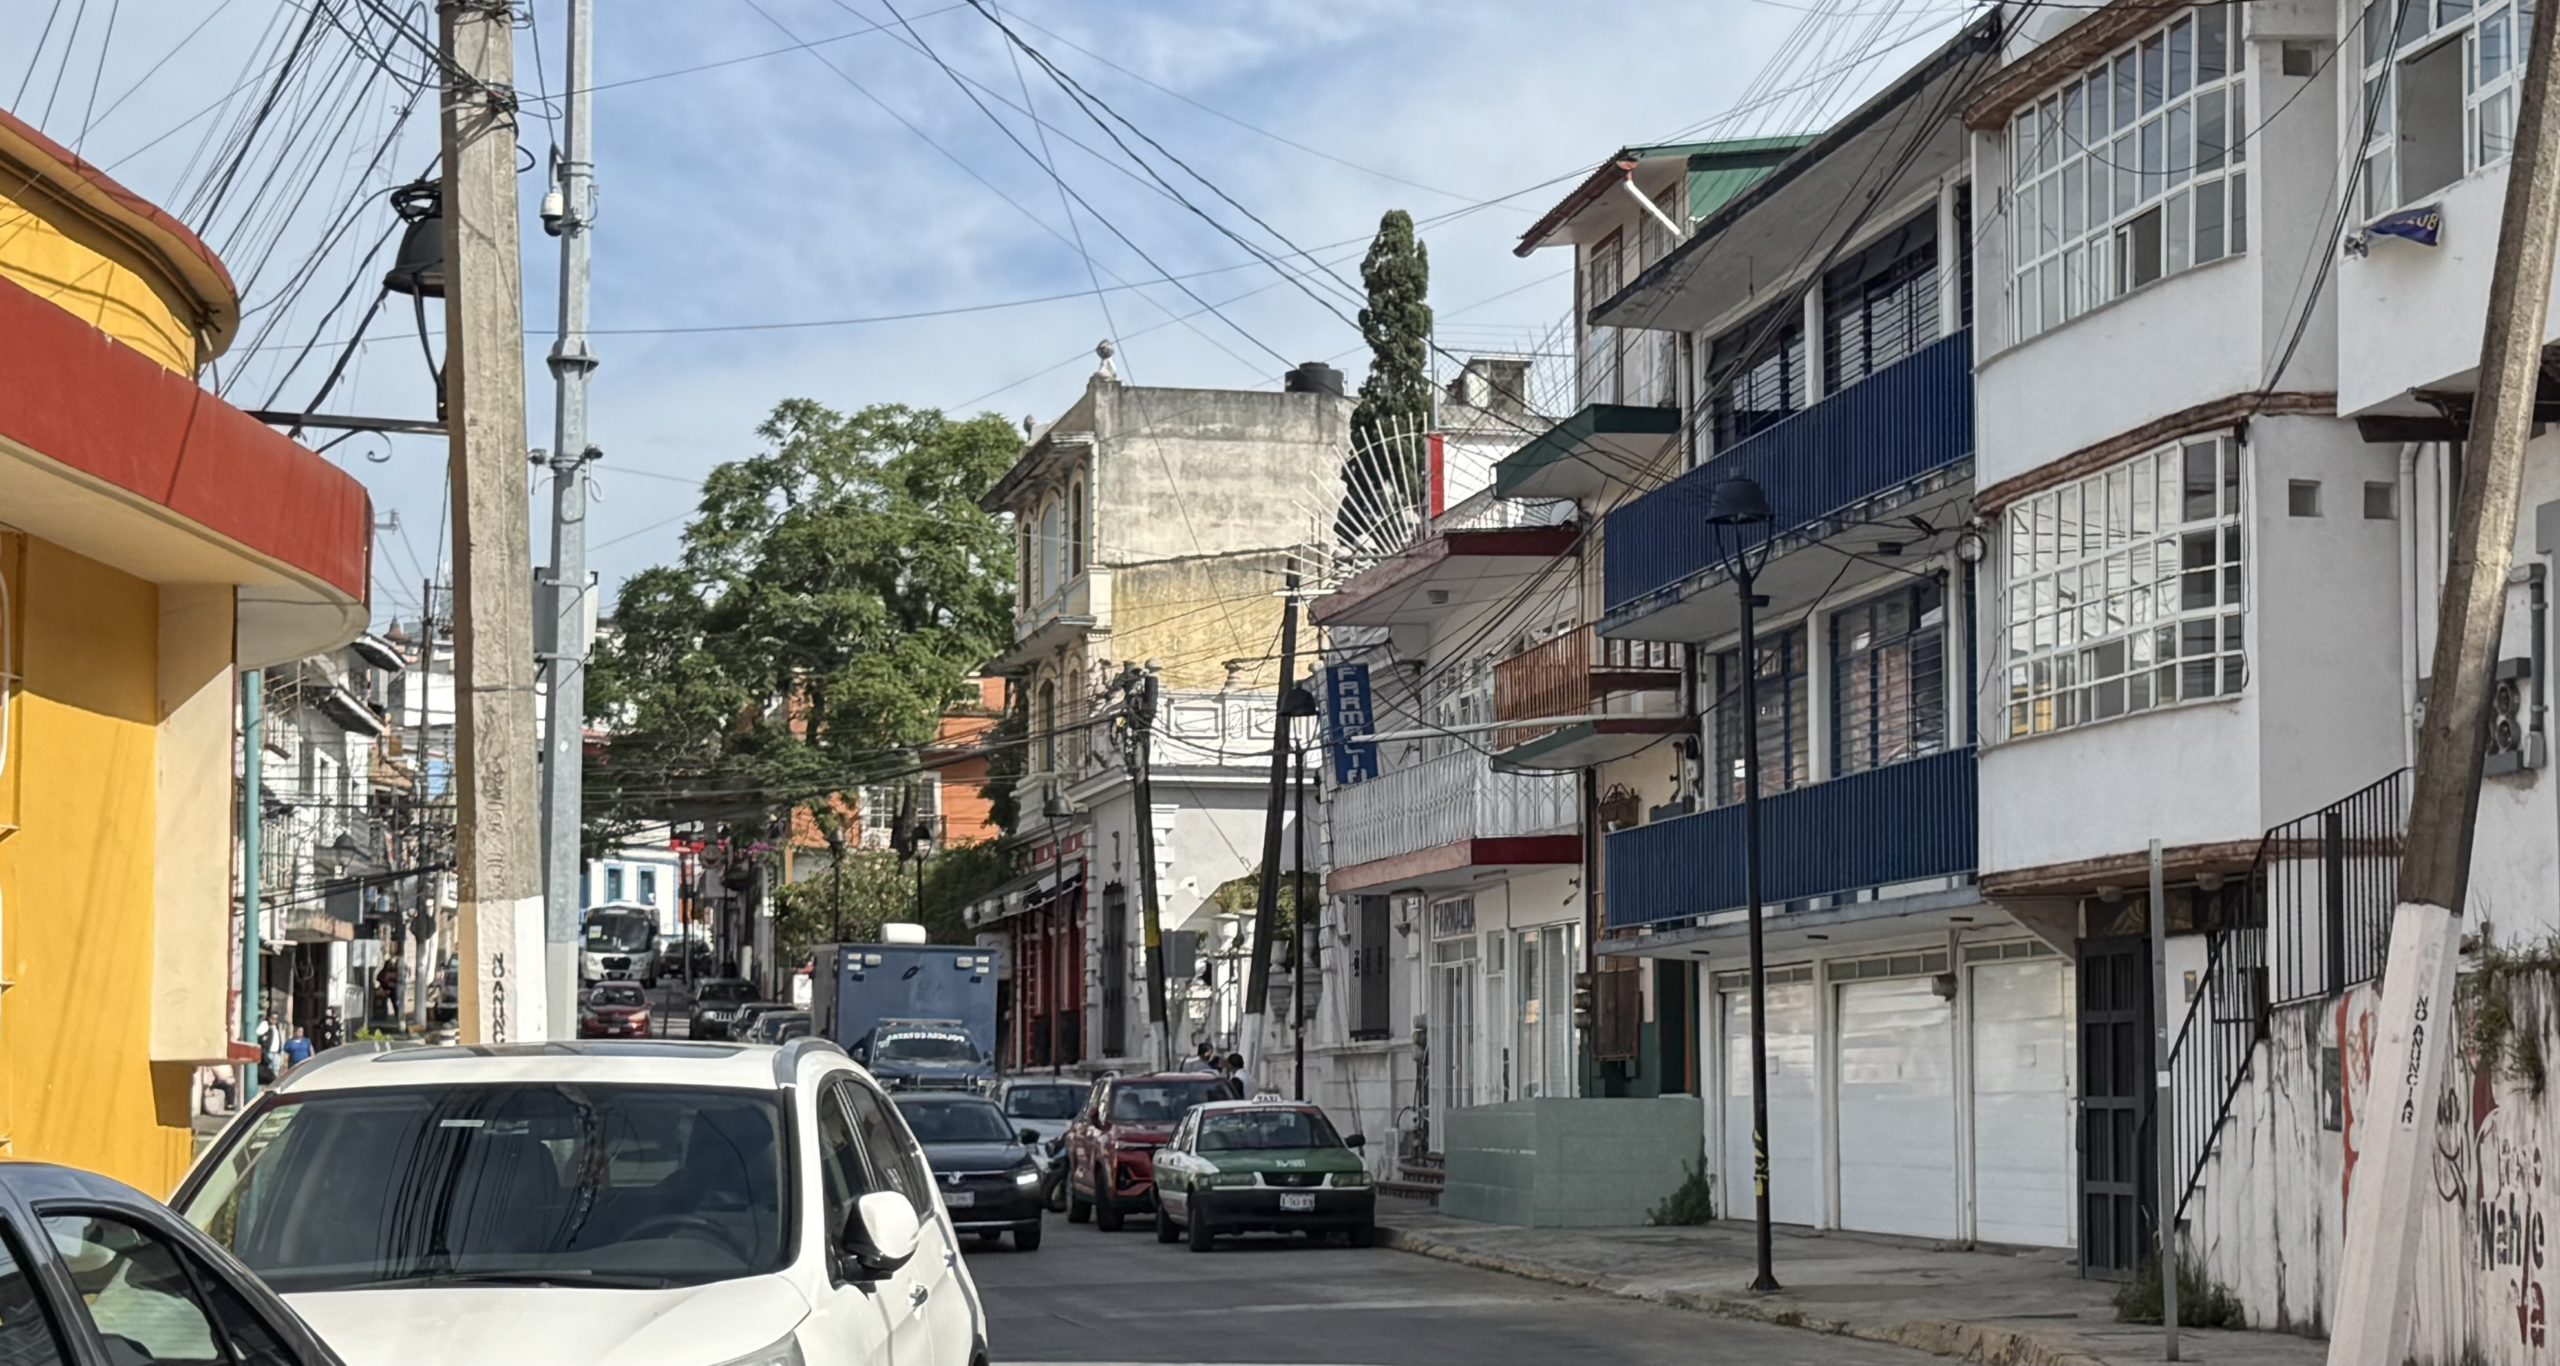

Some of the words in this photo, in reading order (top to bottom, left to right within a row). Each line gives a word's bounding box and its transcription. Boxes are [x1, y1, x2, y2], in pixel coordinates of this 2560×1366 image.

[492, 952, 505, 978] NO
[2415, 996, 2429, 1022] NO
[2401, 1024, 2425, 1124] ANUNCIAR
[1257, 1095, 1278, 1103] TAXI
